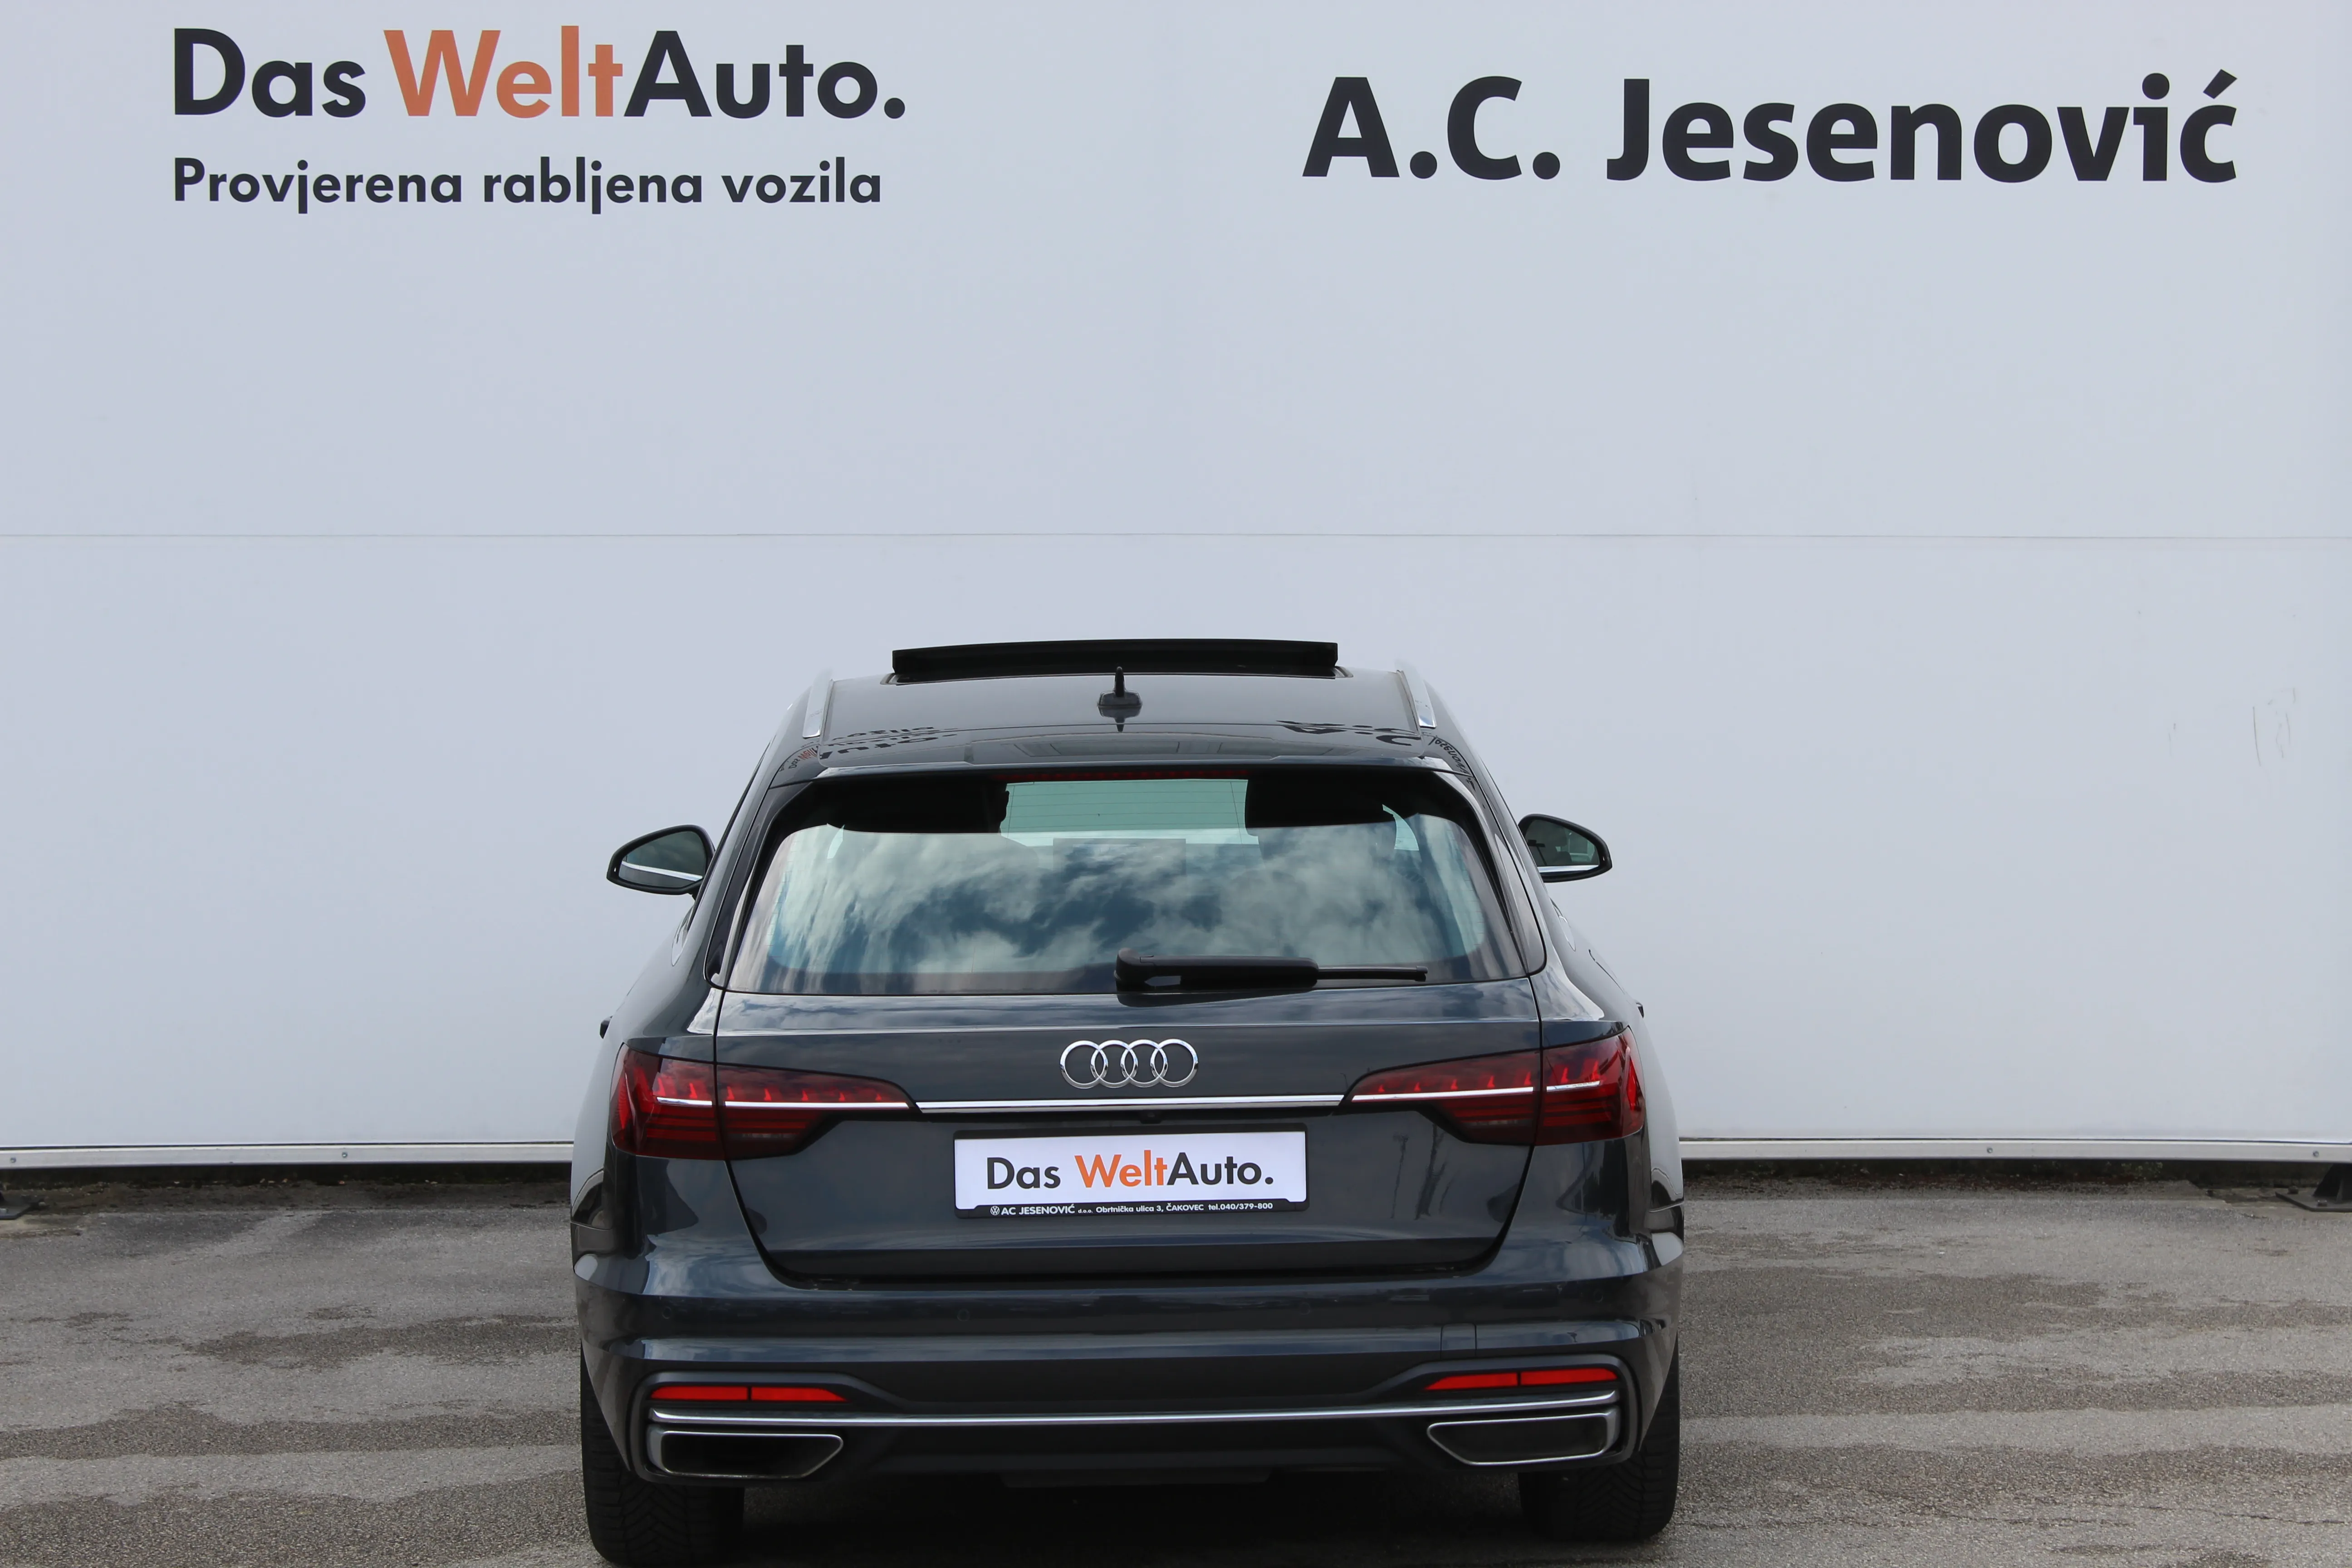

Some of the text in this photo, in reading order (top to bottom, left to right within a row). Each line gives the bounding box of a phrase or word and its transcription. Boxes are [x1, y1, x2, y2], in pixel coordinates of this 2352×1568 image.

[174, 25, 906, 119] Das WeltAuto.
[1302, 69, 2238, 183] A.C. Jesenović
[175, 156, 880, 215] Provjerena rabljena vozila
[987, 1150, 1274, 1190] Das WeltAuto.
[1001, 1207, 1016, 1215] AC
[1019, 1203, 1075, 1215] JESENOVIĆ
[1096, 1205, 1134, 1213] Obrtnička
[1166, 1202, 1204, 1211] ČAKOVEC
[1208, 1202, 1273, 1210] tel.040/379-800
